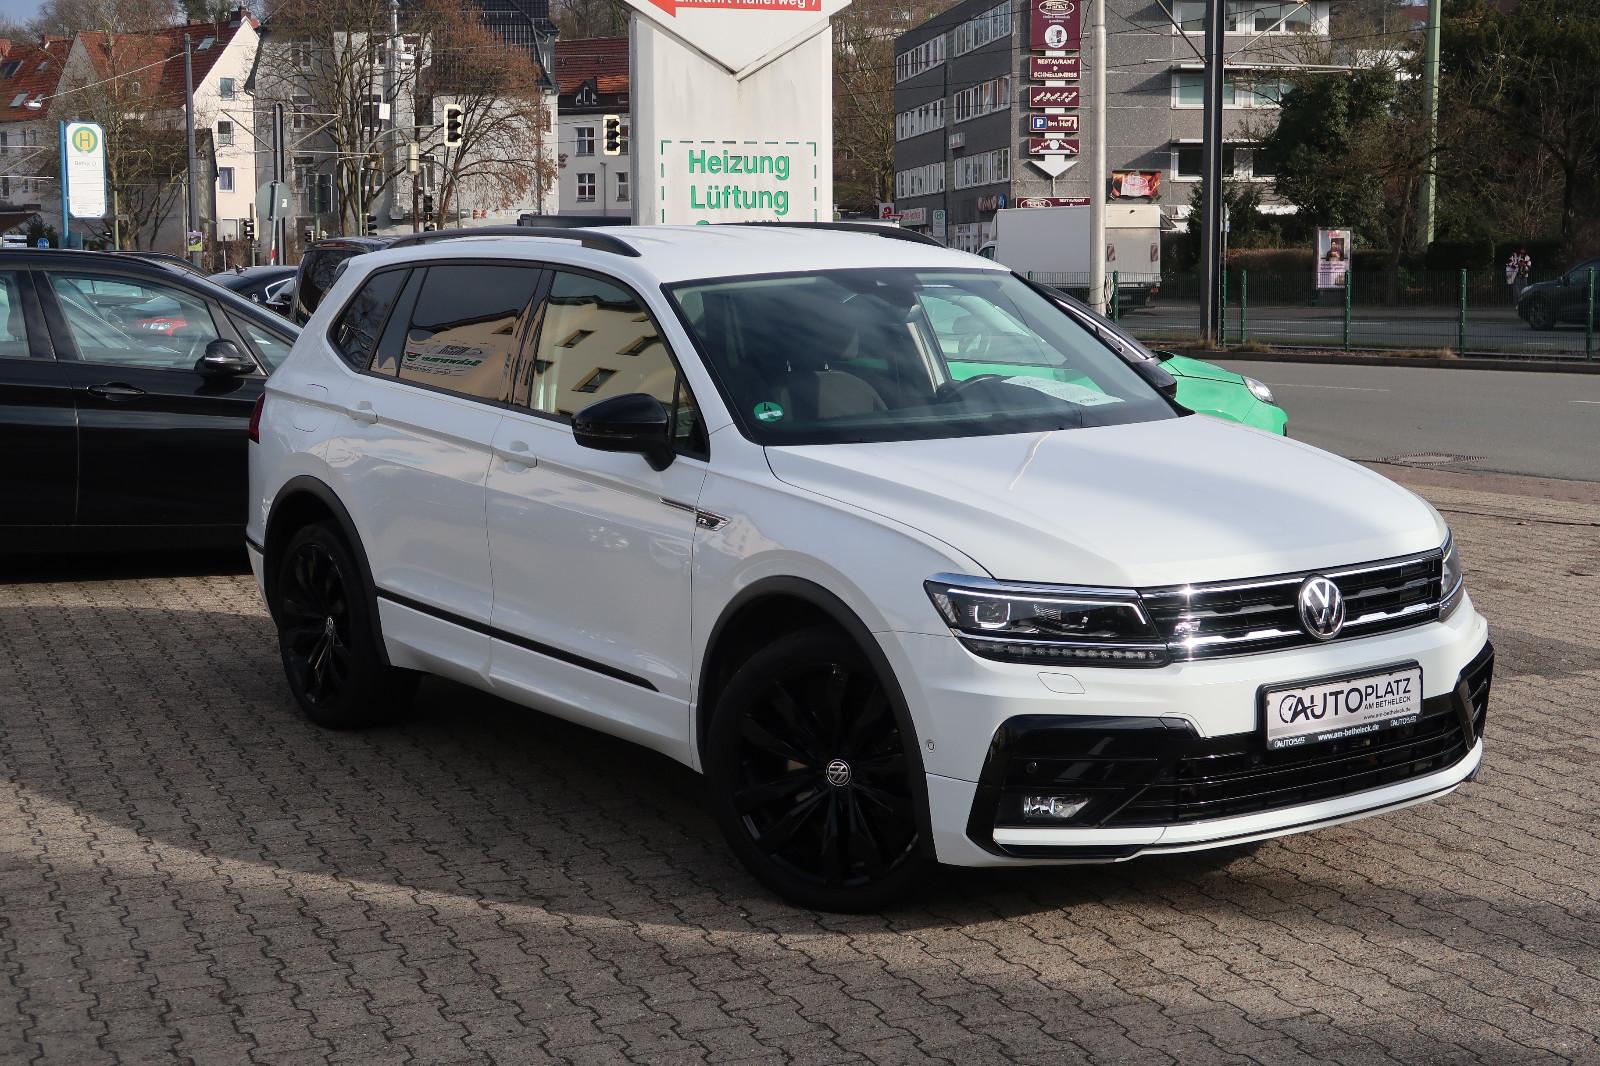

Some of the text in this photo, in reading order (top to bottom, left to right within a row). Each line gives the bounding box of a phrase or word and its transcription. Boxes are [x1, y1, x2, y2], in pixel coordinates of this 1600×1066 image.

[1036, 118, 1044, 128] P
[688, 149, 790, 181] Heizung
[690, 185, 789, 216] Lüftung
[1363, 695, 1412, 711] AM BETHELECK
[1317, 724, 1380, 741] www.am-betheleck.de
